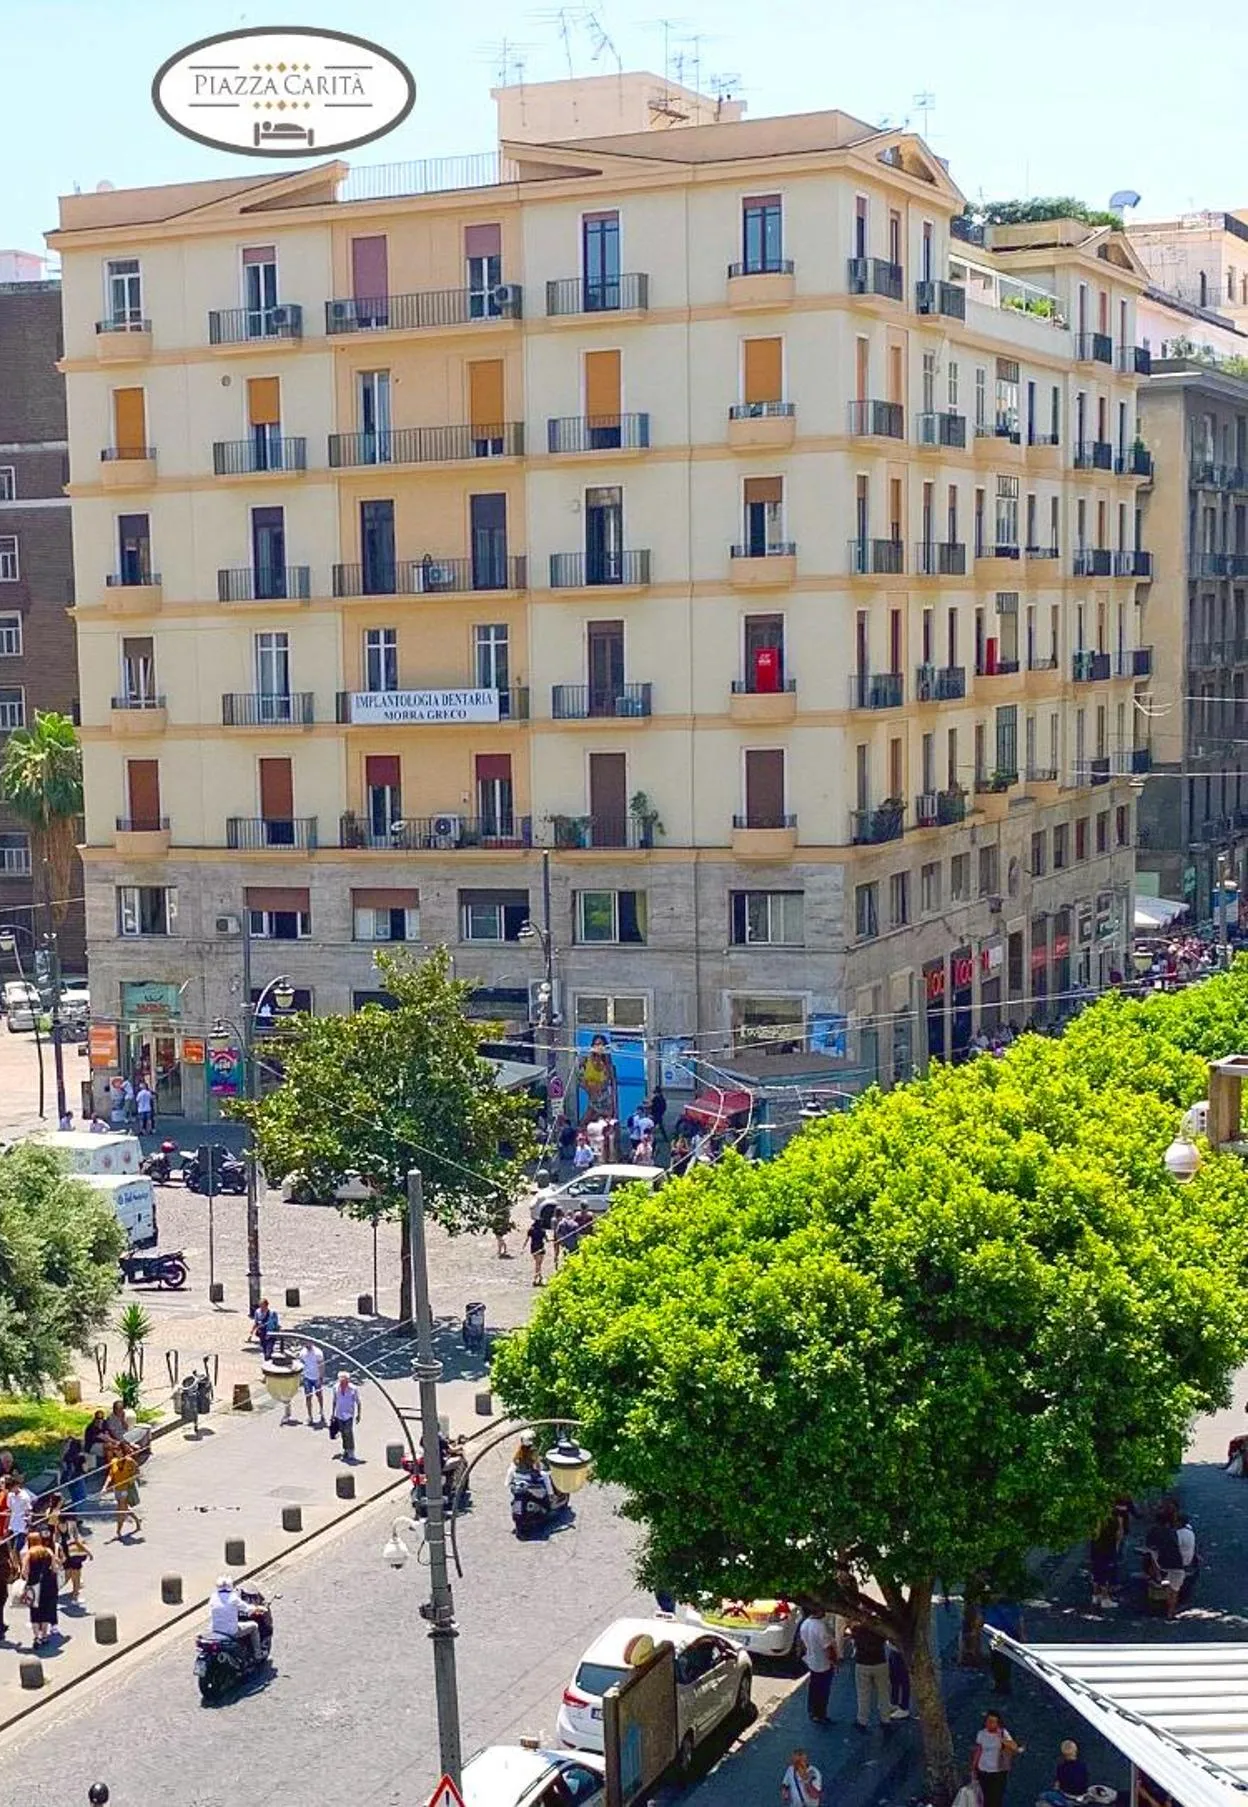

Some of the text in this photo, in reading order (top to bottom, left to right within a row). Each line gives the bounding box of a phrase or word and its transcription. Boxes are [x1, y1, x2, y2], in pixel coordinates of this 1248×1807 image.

[355, 692, 493, 708] IMPLANTOLOGIA DENTARIA
[384, 709, 467, 721] MORRA GRECO
